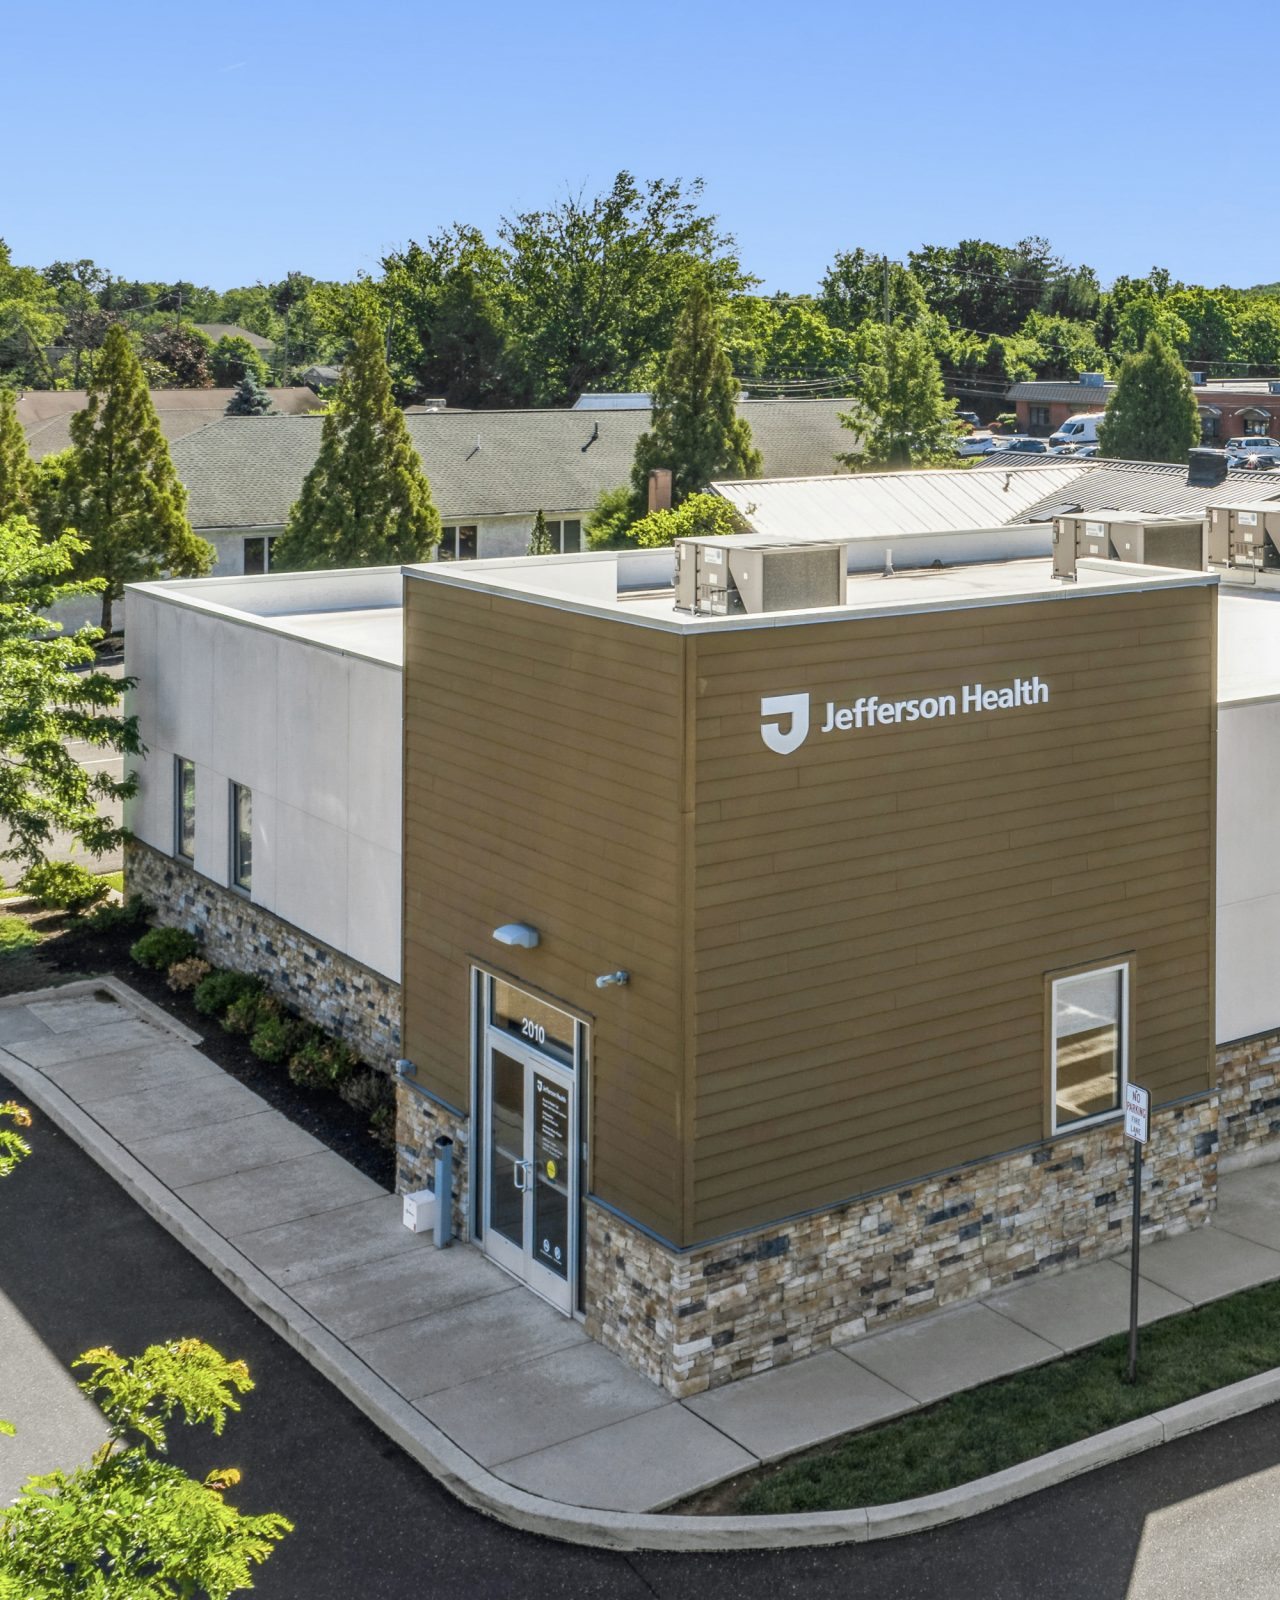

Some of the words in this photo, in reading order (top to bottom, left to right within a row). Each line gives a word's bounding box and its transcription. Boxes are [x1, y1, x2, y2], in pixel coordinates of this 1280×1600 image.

[821, 694, 956, 733] Jefferson
[962, 676, 1049, 713] Health
[522, 1017, 545, 1044] 2010
[1132, 1090, 1140, 1103] NO
[1127, 1102, 1147, 1118] PARKING
[1131, 1116, 1140, 1125] FIRE
[1131, 1125, 1141, 1135] LANE
